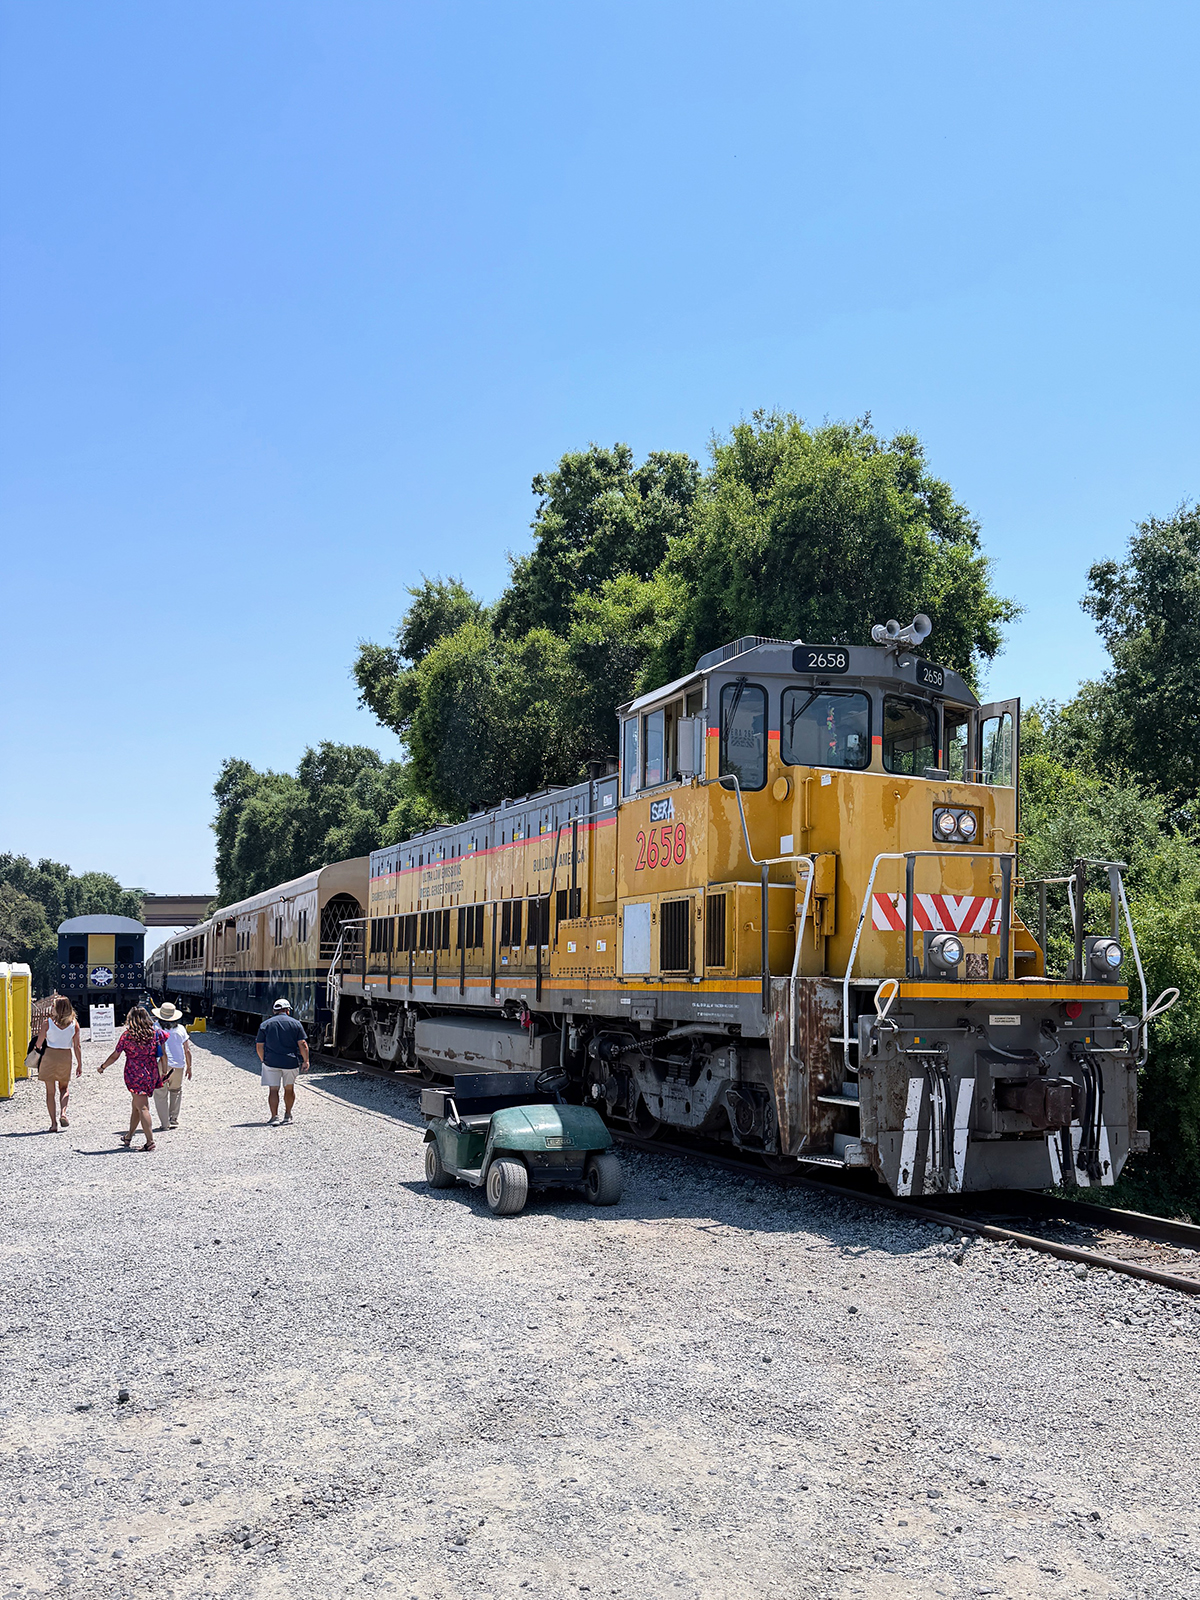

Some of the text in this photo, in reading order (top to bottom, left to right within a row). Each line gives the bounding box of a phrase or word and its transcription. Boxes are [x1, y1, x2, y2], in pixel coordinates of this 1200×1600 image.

[807, 653, 846, 668] 2658
[922, 667, 943, 686] 2658
[651, 796, 676, 823] SERA
[634, 822, 687, 871] 2658
[533, 855, 555, 872] BUILDIN
